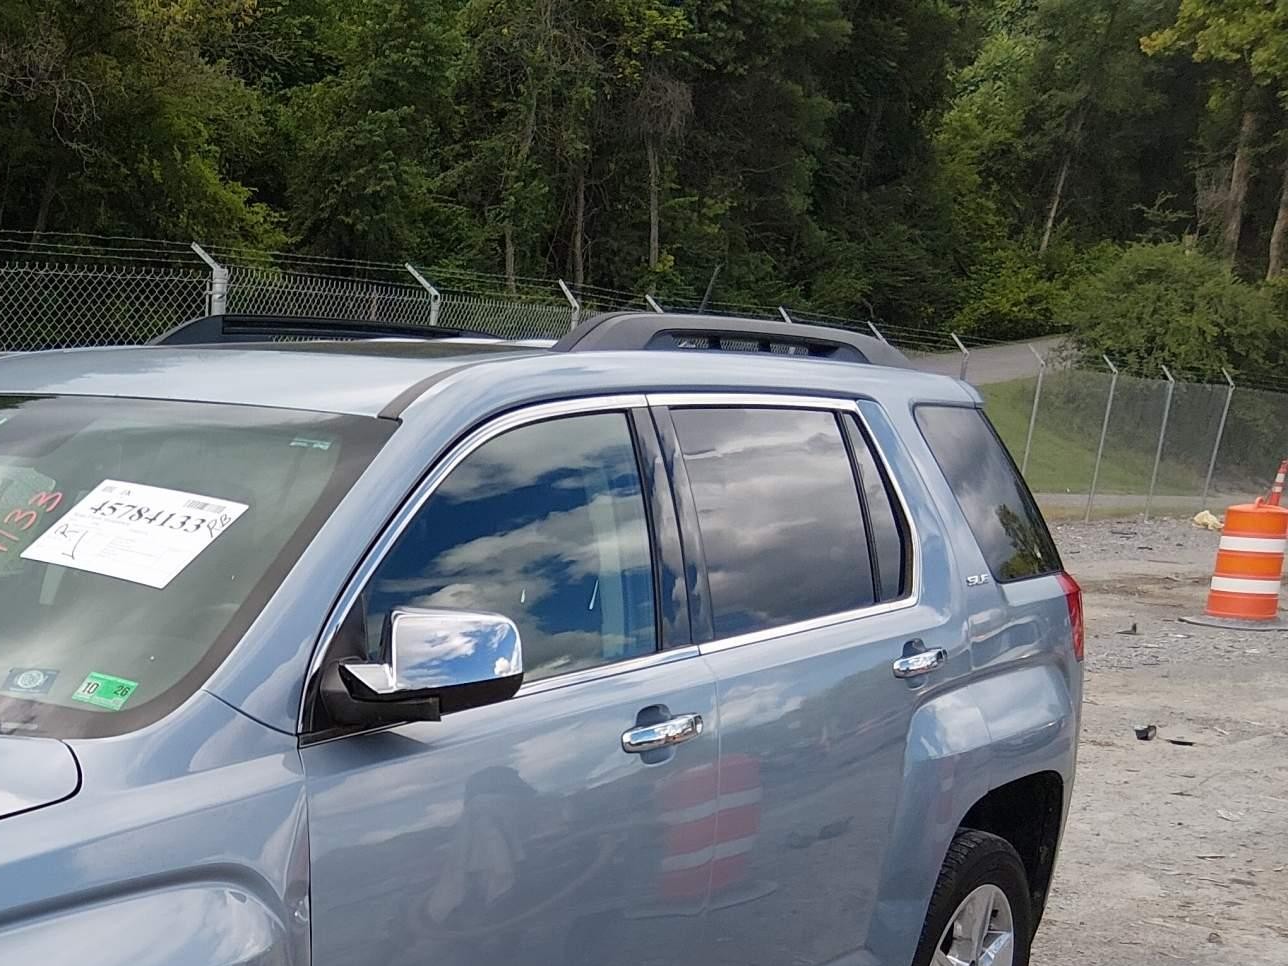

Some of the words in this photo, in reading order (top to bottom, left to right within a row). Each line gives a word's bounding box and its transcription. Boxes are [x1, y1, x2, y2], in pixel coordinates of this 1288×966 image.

[90, 500, 206, 533] 45784133
[82, 682, 100, 695] 10
[114, 685, 131, 697] 26
